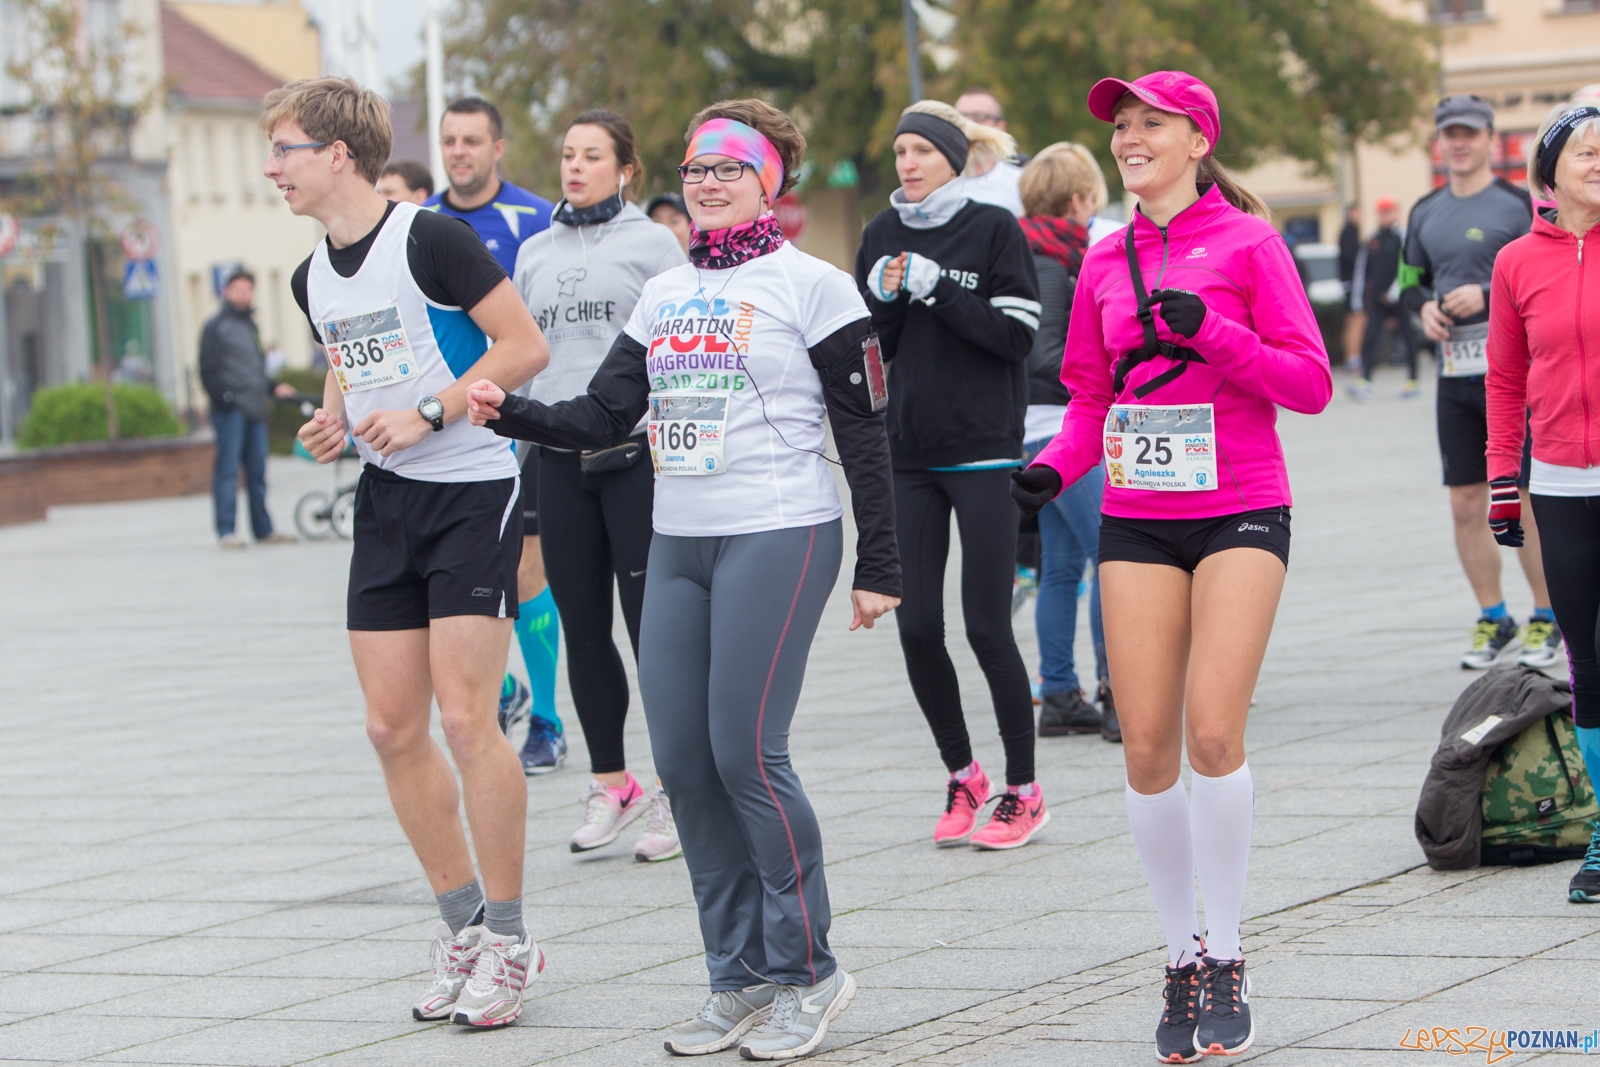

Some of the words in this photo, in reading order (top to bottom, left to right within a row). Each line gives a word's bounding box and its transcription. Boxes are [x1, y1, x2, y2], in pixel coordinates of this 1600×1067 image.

[565, 300, 616, 322] CHIEF
[652, 318, 735, 338] MARATON
[340, 338, 384, 369] 336
[1452, 341, 1484, 359] 512
[361, 369, 372, 378] Jan
[659, 422, 697, 451] 166
[665, 453, 685, 462] Joanna
[1134, 436, 1173, 466] 25
[1134, 468, 1176, 478] Agnieszka
[1133, 479, 1161, 487] POLINOVA
